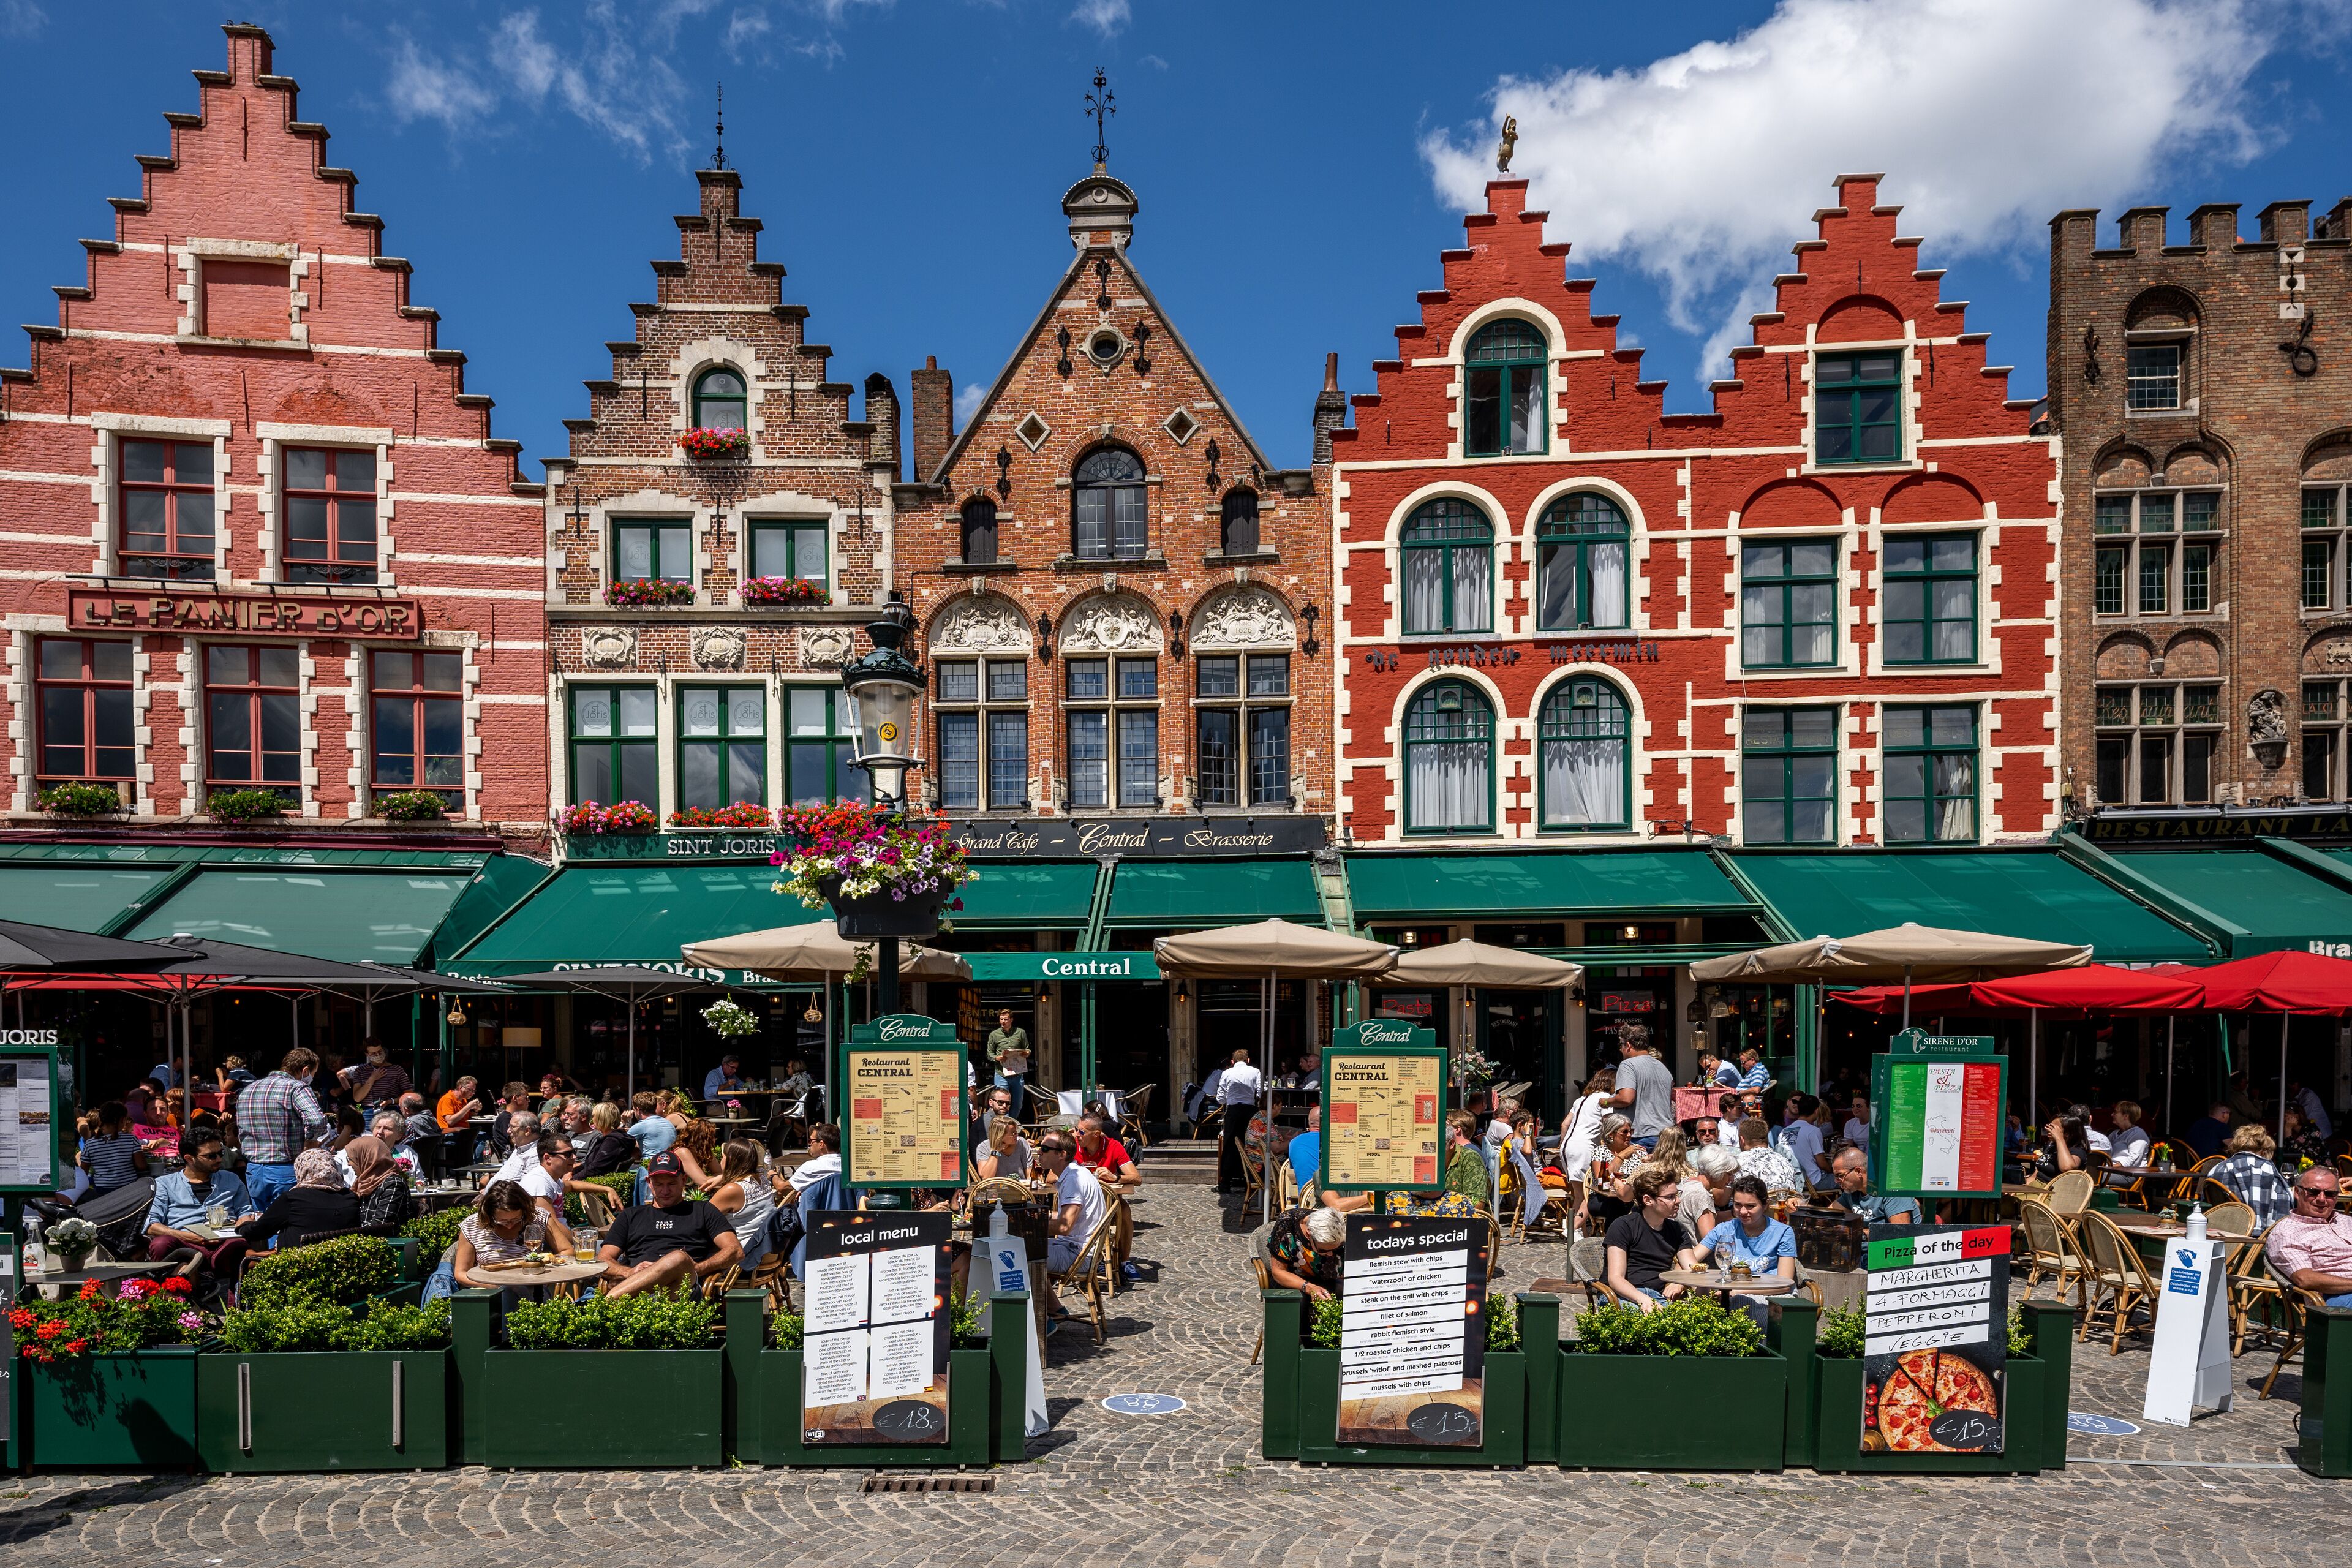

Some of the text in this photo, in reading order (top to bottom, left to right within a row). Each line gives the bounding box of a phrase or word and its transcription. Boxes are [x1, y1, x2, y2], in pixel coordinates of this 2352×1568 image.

[85, 598, 409, 633] LE PANIER D'OR
[1372, 638, 1659, 668] de gouden meermin
[586, 710, 608, 719] Joris
[693, 710, 715, 718] Joris
[738, 710, 760, 718] Joris
[2094, 818, 2294, 838] RESTAURANT
[668, 839, 776, 854] SINT JORIS
[951, 832, 1003, 850] Grand
[1077, 823, 1150, 854] Central
[1184, 829, 1273, 847] Brasserie
[2309, 940, 2352, 957] Bra
[1042, 957, 1131, 976] Central
[1383, 997, 1431, 1015] Pasta
[1604, 995, 1650, 1011] Pizza
[879, 1018, 932, 1041] Central
[1491, 1019, 1518, 1028] RESTAURANT
[1359, 1023, 1412, 1046] Central
[861, 1058, 910, 1067] Restaurant
[1338, 1061, 1385, 1071] Restaurant
[858, 1068, 913, 1077] CENTRAL
[1334, 1072, 1388, 1081] CENTRAL
[841, 1226, 919, 1245] local menu
[1367, 1229, 1468, 1250] todays special
[1884, 1236, 1994, 1259] Pizza of the day
[1880, 1265, 1981, 1286] MARGHERITA
[1871, 1305, 1977, 1329] PEPPERONI
